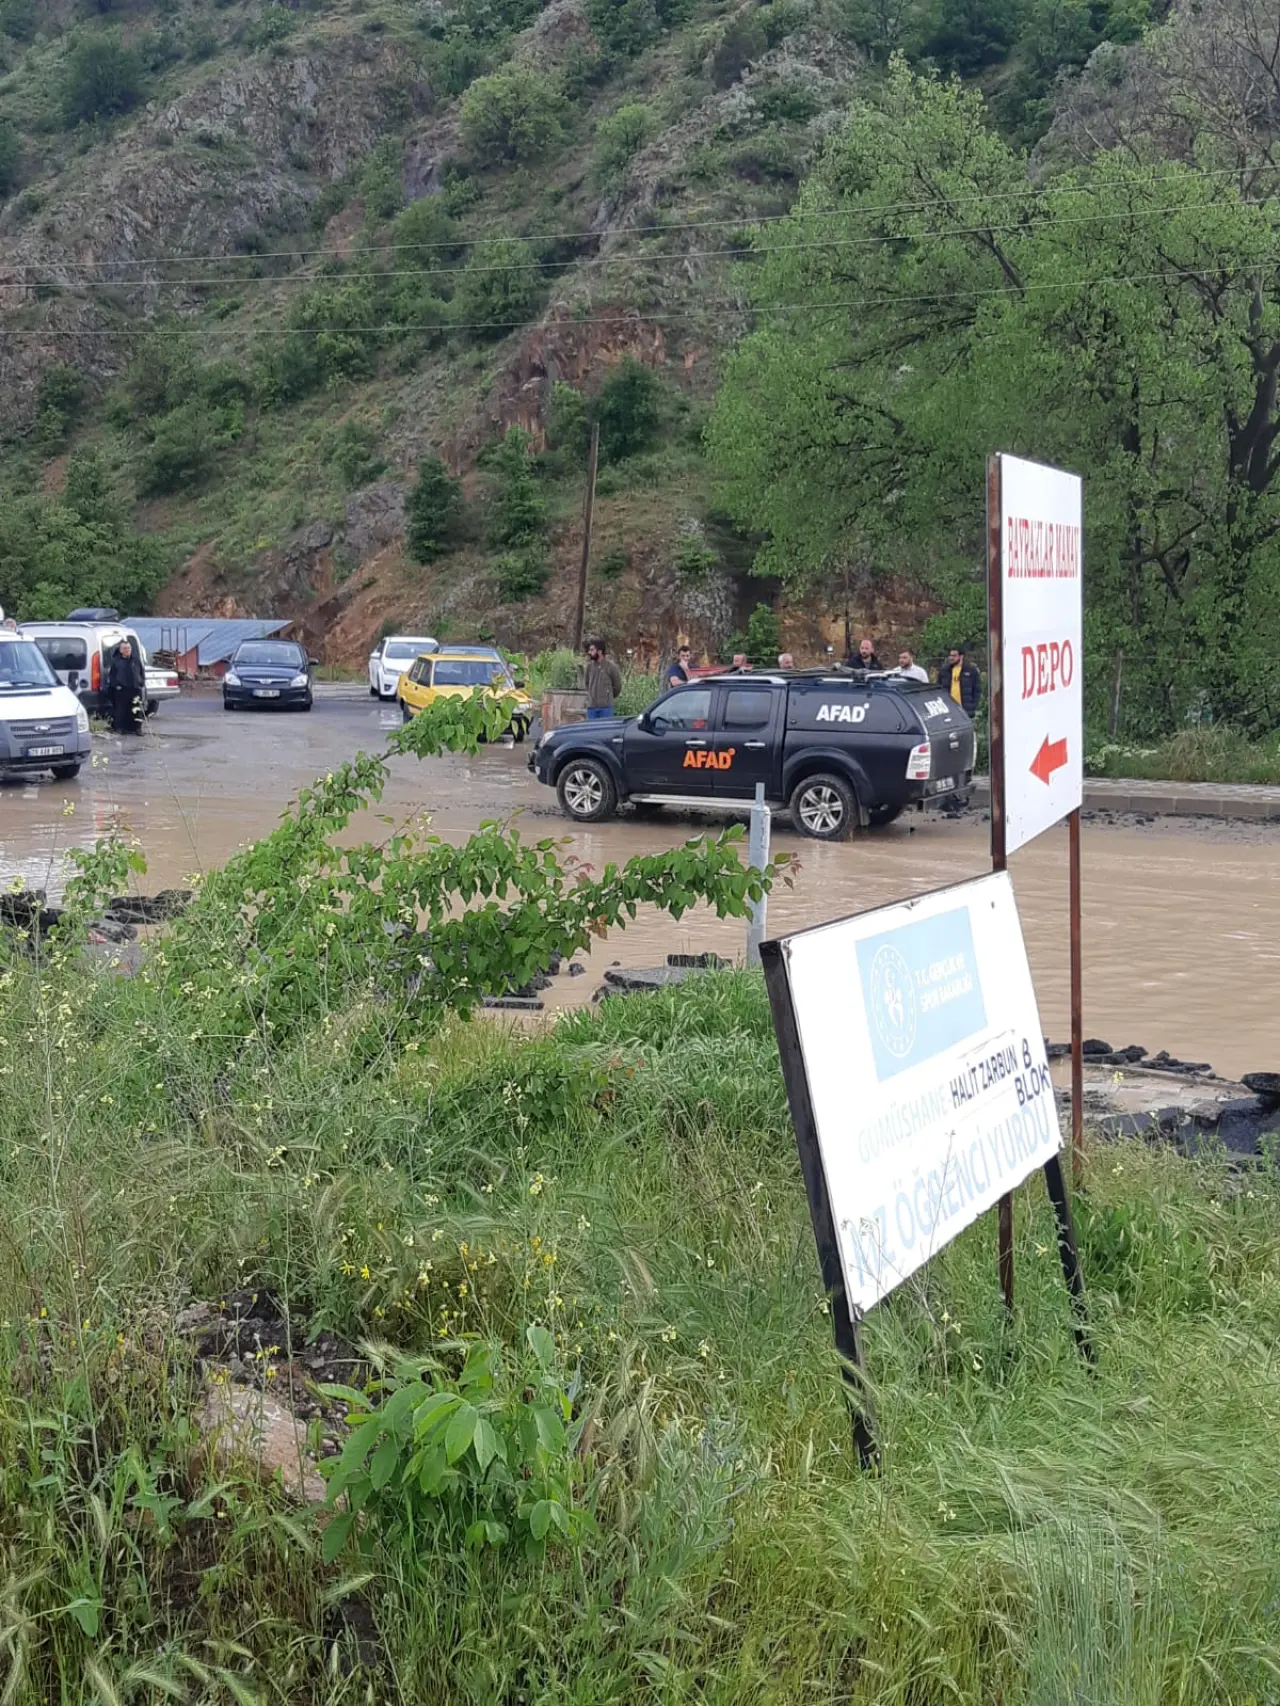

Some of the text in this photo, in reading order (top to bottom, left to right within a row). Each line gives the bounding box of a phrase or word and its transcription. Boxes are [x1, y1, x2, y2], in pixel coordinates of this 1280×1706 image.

[1021, 639, 1073, 700] DEPO
[816, 704, 866, 723] AFAD
[683, 750, 733, 770] AFAD
[979, 1044, 1018, 1091] ZARBUN
[1022, 1038, 1032, 1069] B
[1014, 1062, 1051, 1107] BLOK
[987, 1095, 1050, 1178] YURDU
